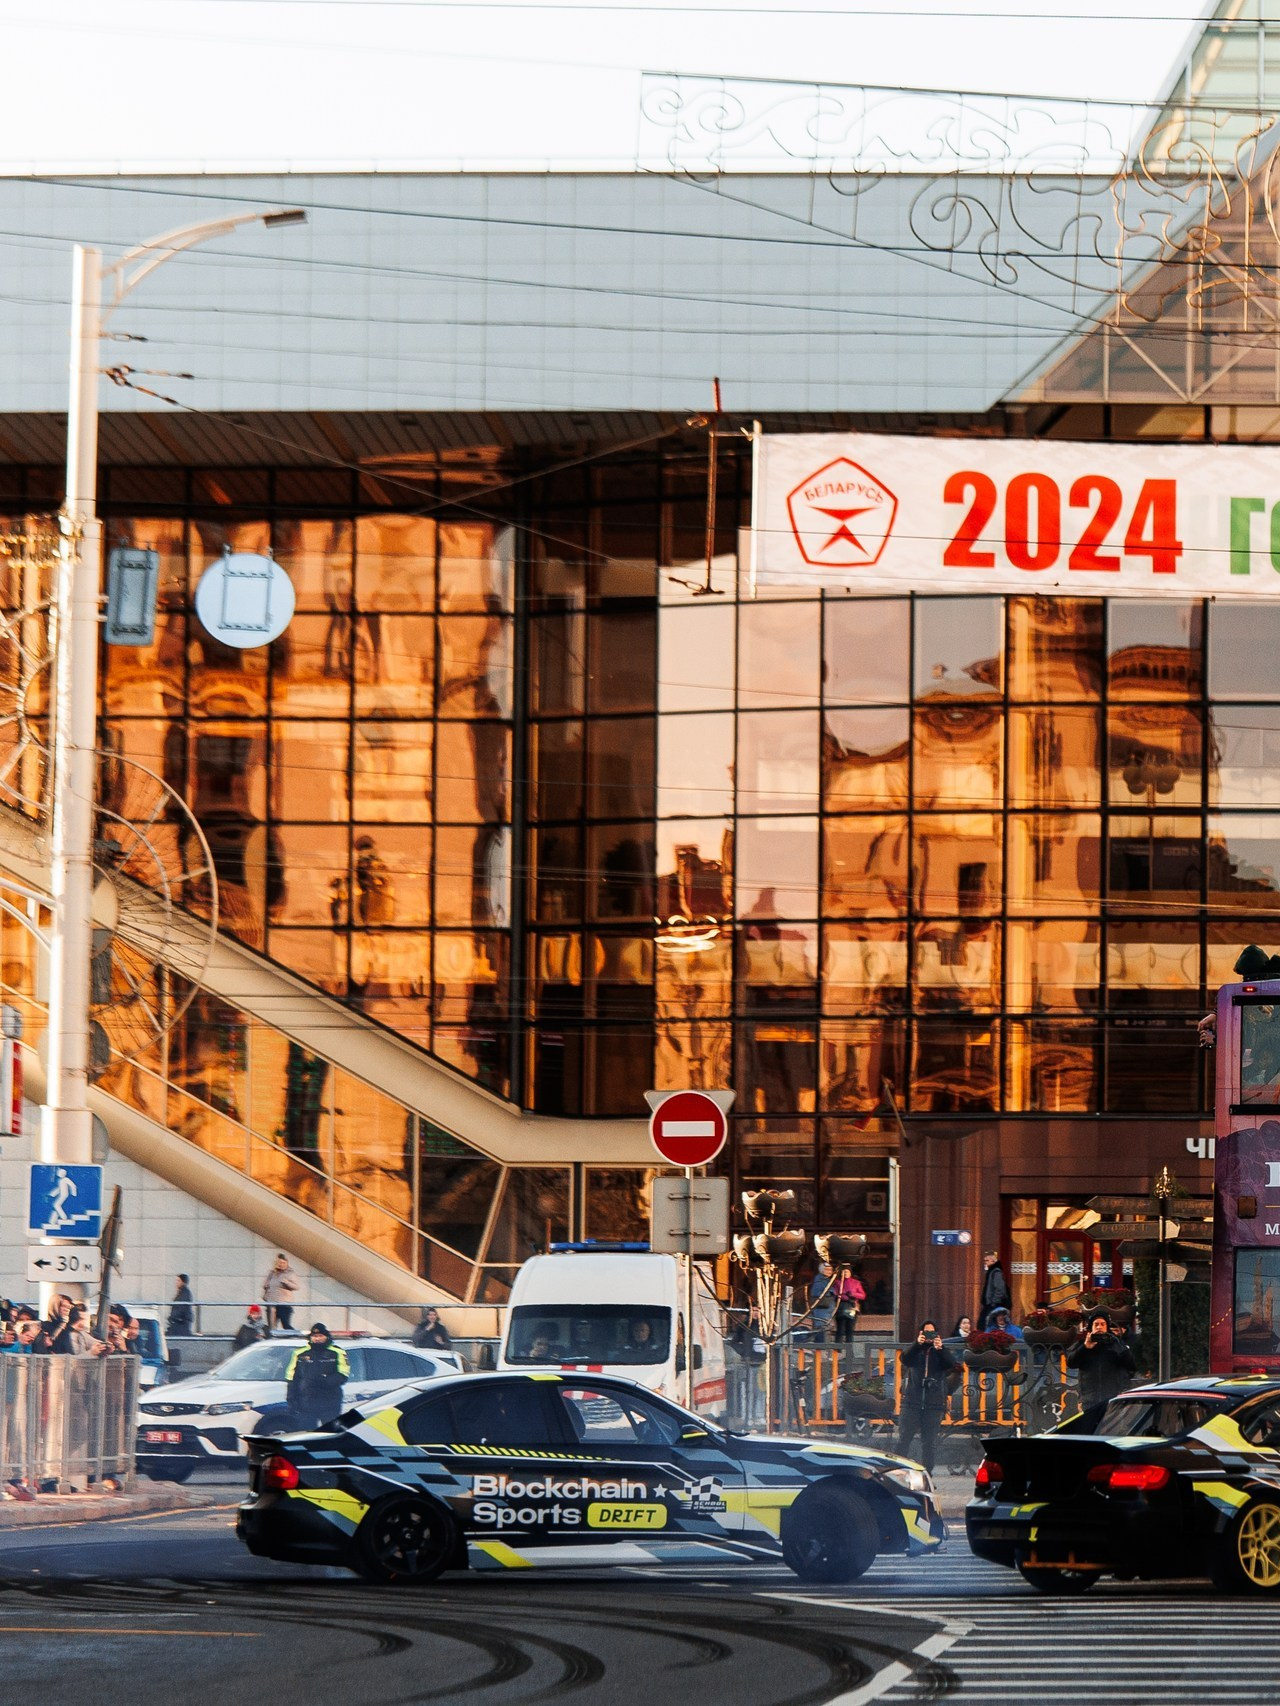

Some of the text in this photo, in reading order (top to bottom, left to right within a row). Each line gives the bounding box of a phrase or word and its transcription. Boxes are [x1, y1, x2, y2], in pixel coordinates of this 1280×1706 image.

[804, 482, 884, 503] БЕЛАРУСЬ
[943, 470, 1183, 574] 2024
[57, 1255, 79, 1272] 30
[473, 1475, 647, 1499] Blockchain
[473, 1502, 657, 1528] Sports DRIFT
